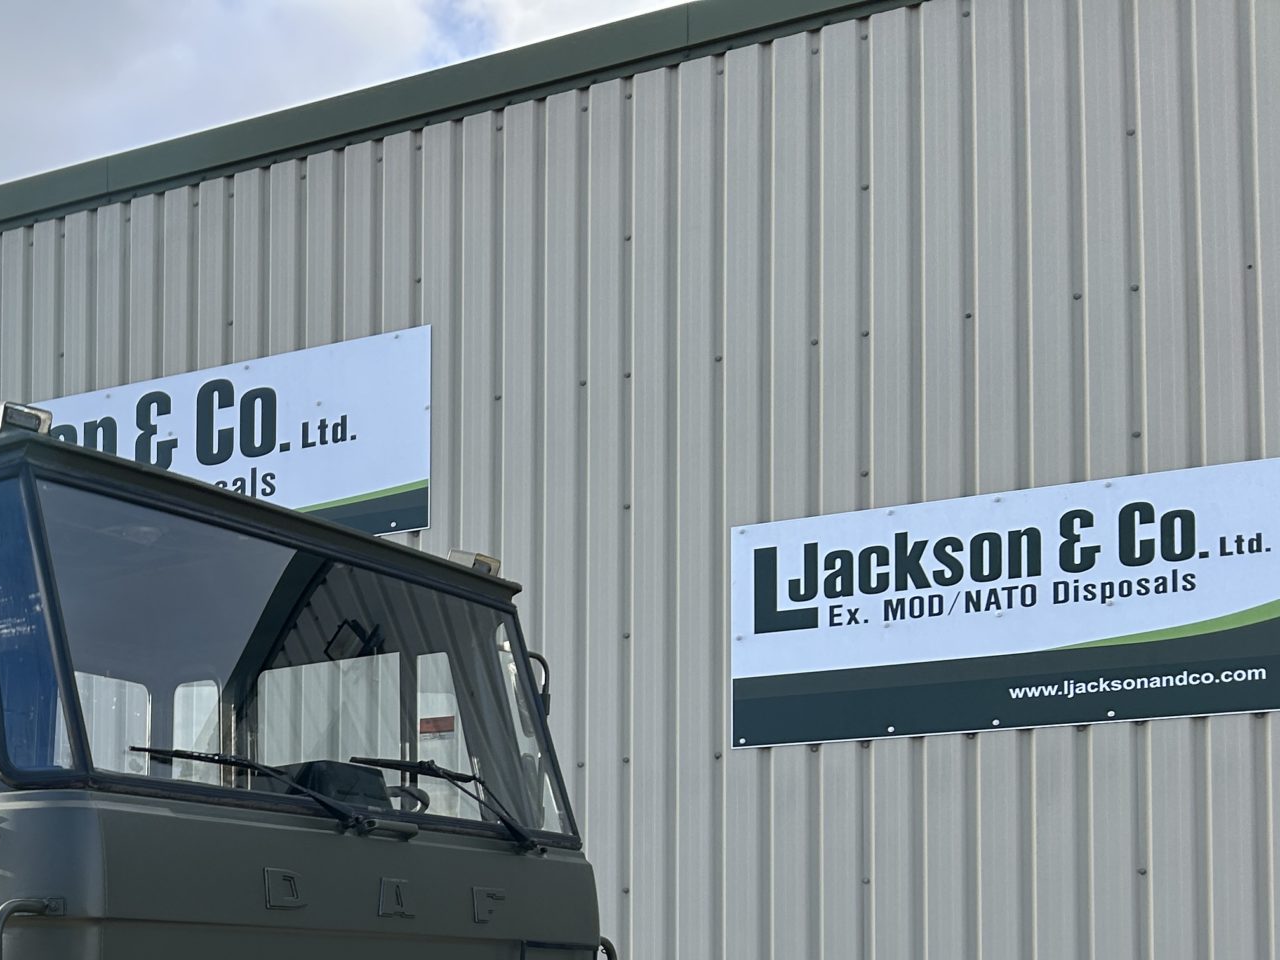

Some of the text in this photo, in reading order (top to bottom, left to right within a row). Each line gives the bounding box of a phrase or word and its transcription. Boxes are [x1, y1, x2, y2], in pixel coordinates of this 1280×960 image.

[196, 378, 290, 466] Co.
[301, 414, 357, 449] Ltd.
[1059, 509, 1101, 573] &
[1118, 501, 1209, 567] Co.
[1219, 532, 1272, 557] Ltd.
[829, 568, 1197, 627] Ex. MOD/NATO Disposals
[1009, 667, 1267, 698] www.ljacksonandco.com
